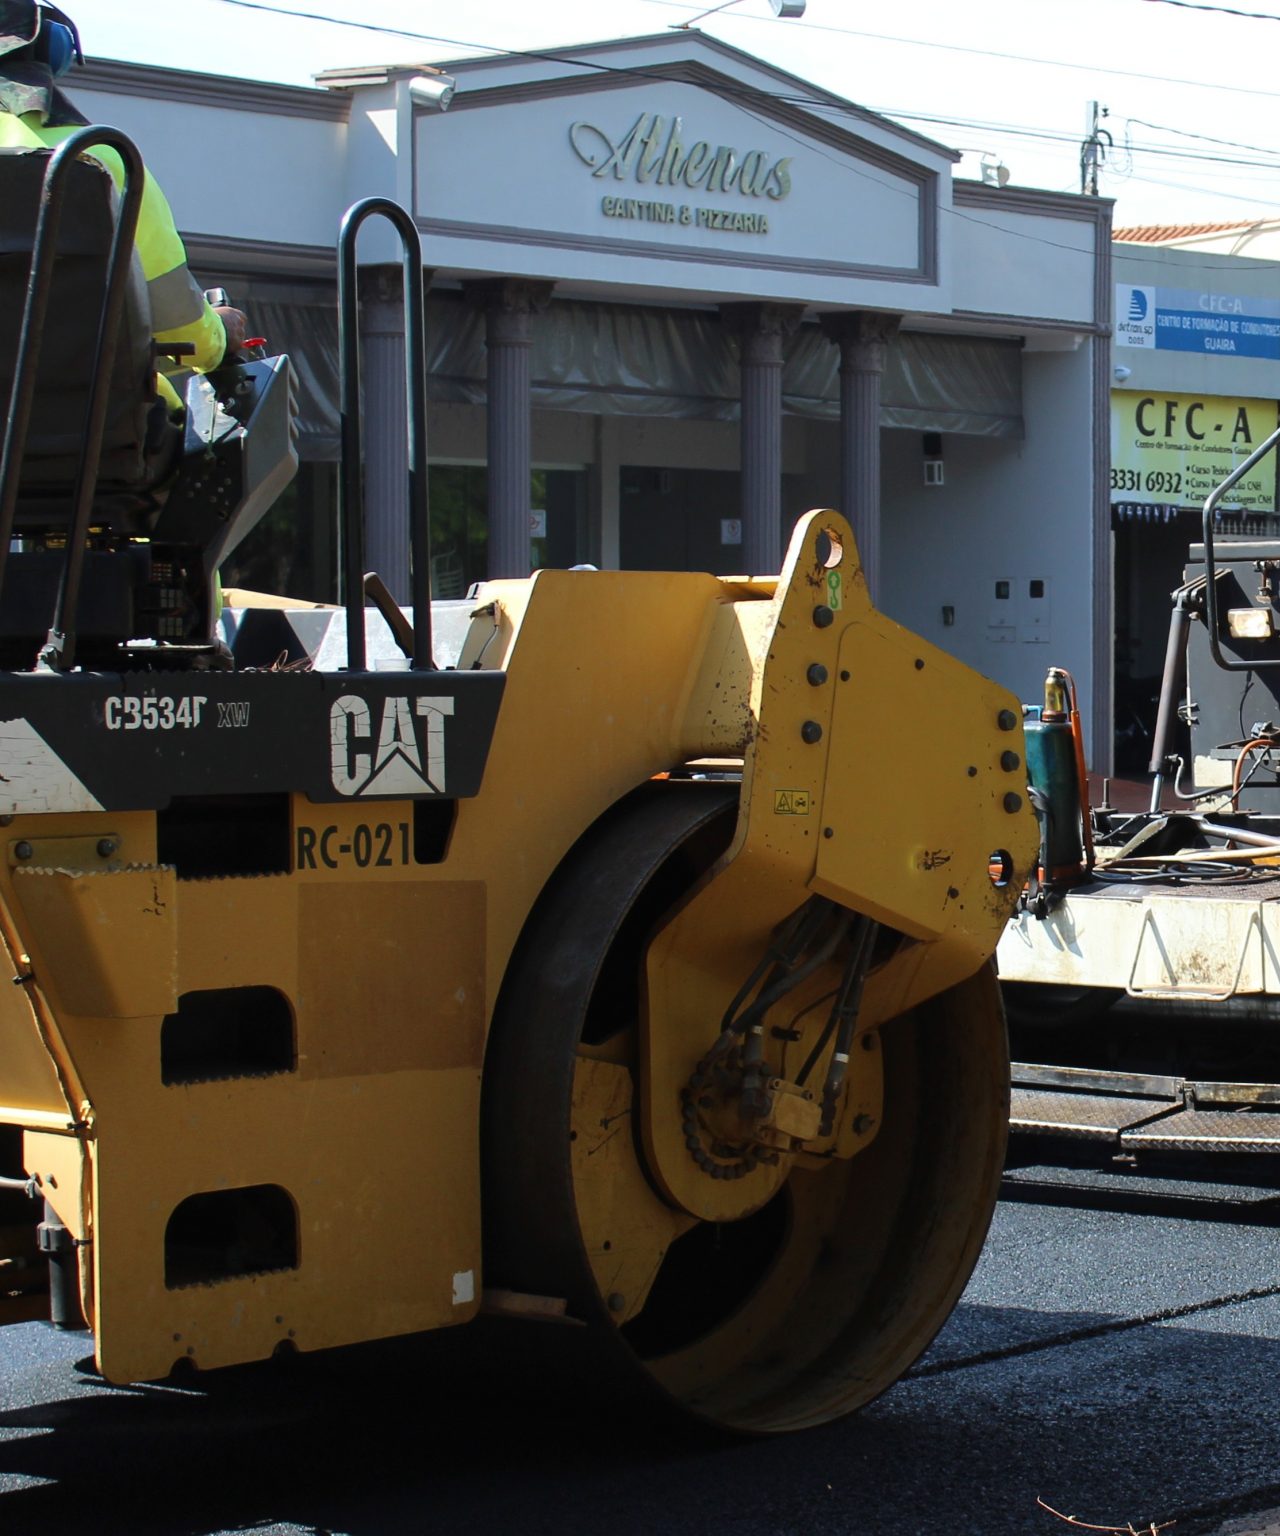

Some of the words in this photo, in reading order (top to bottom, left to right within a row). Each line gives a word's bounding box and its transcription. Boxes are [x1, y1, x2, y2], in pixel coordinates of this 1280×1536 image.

[569, 112, 793, 201] Athenas
[602, 196, 675, 224] CANTINA
[679, 205, 691, 225] &
[696, 208, 768, 234] PIZZARIA
[1146, 472, 1182, 493] 6932
[216, 702, 251, 728] XW
[330, 694, 454, 796] CAT
[297, 823, 410, 869] RC-021
